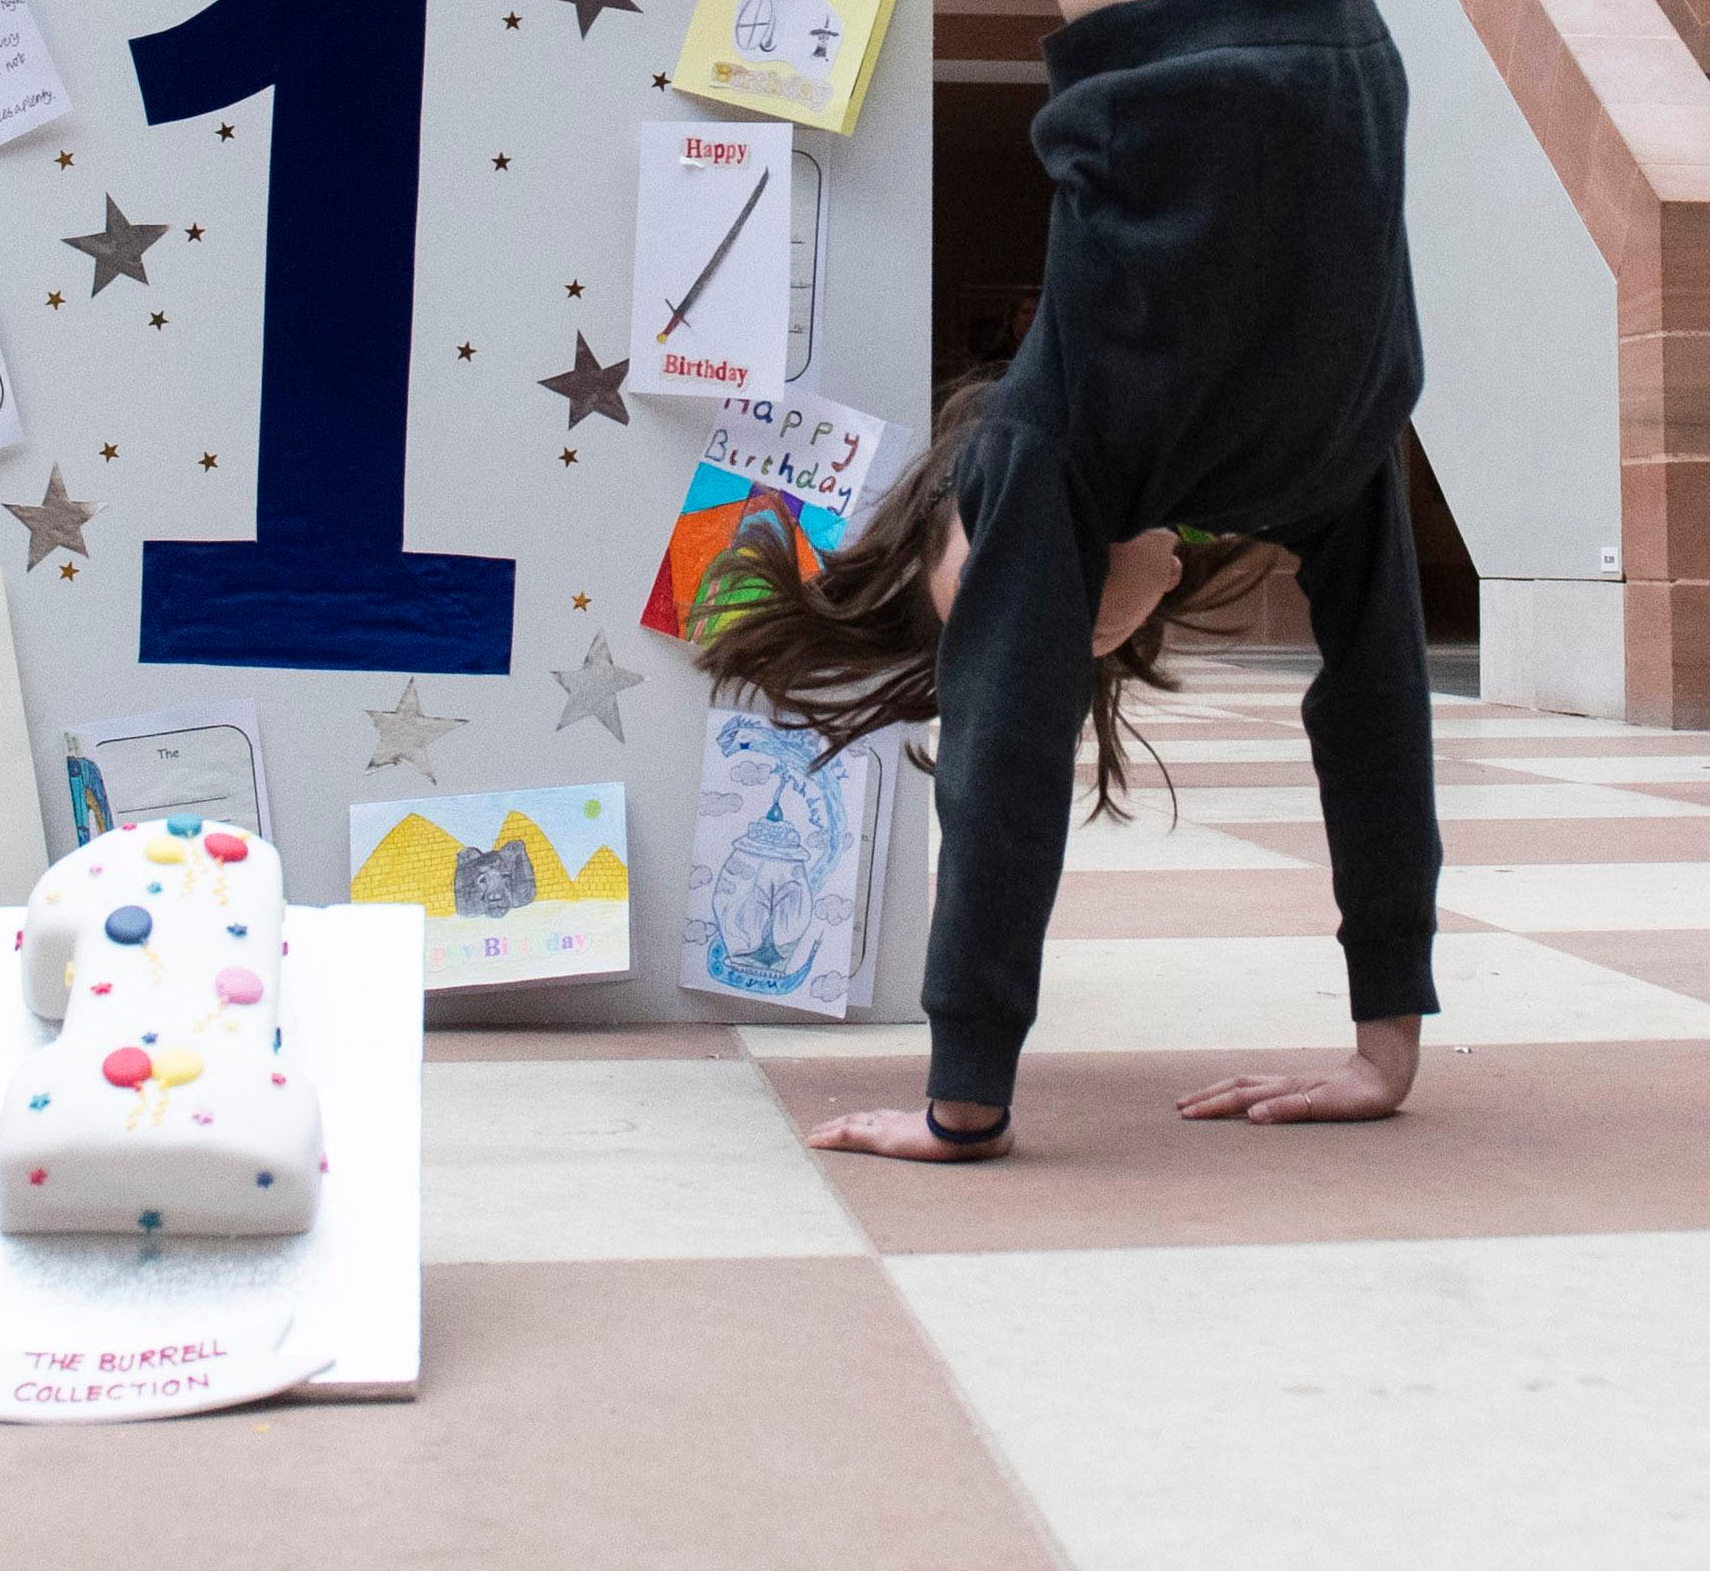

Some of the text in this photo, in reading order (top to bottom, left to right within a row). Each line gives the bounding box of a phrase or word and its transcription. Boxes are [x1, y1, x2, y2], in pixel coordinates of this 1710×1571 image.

[5, 52, 25, 70] not
[686, 138, 748, 164] Happy
[663, 354, 748, 387] Birthday
[704, 429, 852, 516] Birthday
[158, 748, 180, 760] The
[25, 1340, 227, 1373] THE BURRELL
[15, 1374, 209, 1403] COLLECTION
